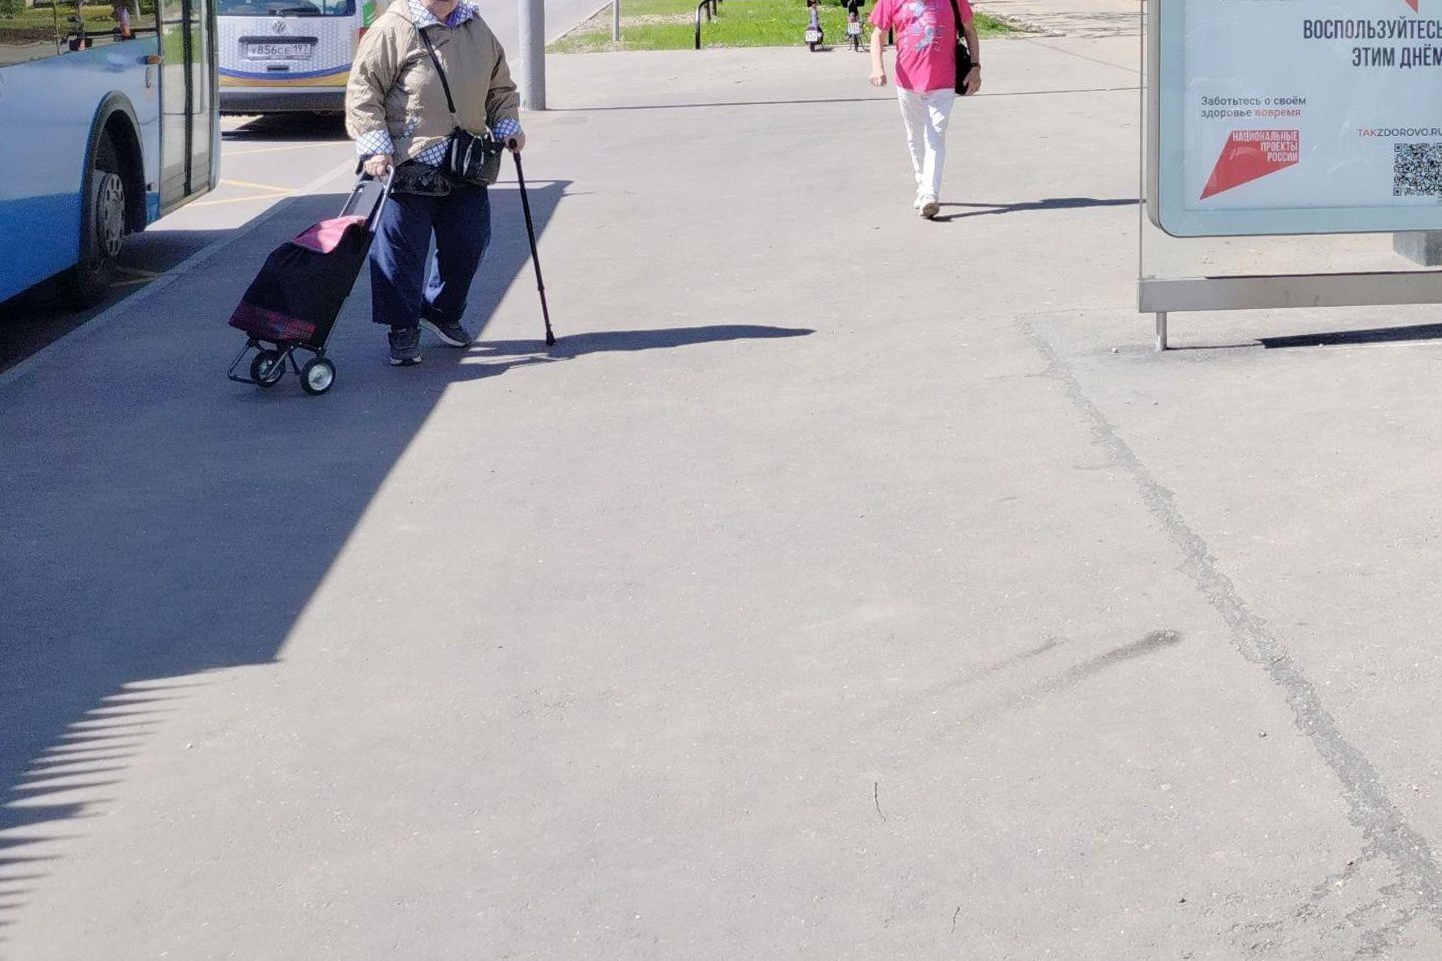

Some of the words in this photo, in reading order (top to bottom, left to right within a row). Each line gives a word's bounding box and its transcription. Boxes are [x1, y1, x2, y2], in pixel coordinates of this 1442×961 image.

[1352, 46, 1395, 67] ЭТИМ
[1201, 95, 1262, 106] Заботьтесь
[1264, 98, 1271, 106] о
[1273, 96, 1306, 106] своём
[1201, 109, 1252, 119] здоровье
[1254, 109, 1301, 118] вовремя
[1232, 131, 1298, 143] НАЦИОНАЛЬНЫЕ
[1260, 141, 1298, 152] ПРОЕКТЫ
[1267, 152, 1298, 163] РОССИИ
